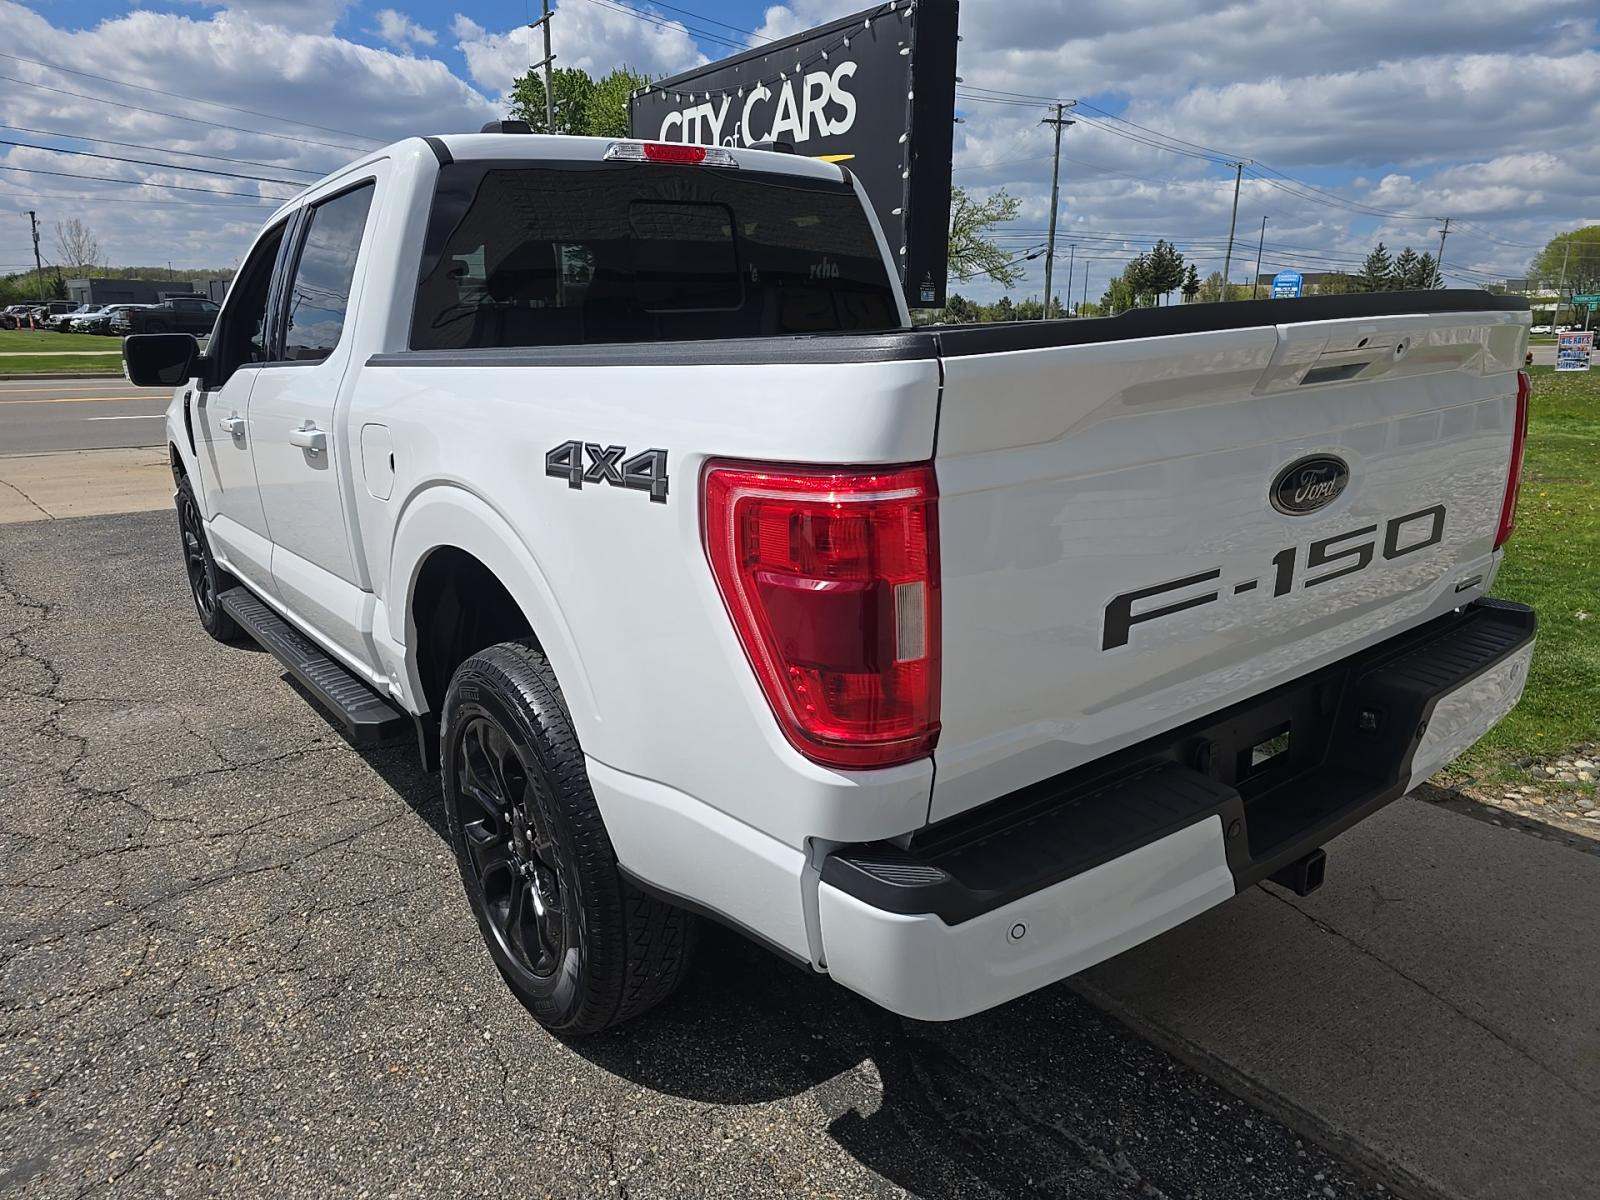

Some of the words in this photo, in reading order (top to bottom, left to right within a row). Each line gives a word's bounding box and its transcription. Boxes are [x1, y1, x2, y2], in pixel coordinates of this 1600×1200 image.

[660, 97, 732, 148] CITY
[723, 122, 741, 148] of
[741, 61, 858, 149] CARS
[1295, 467, 1338, 502] Ford
[1102, 504, 1446, 651] F-150
